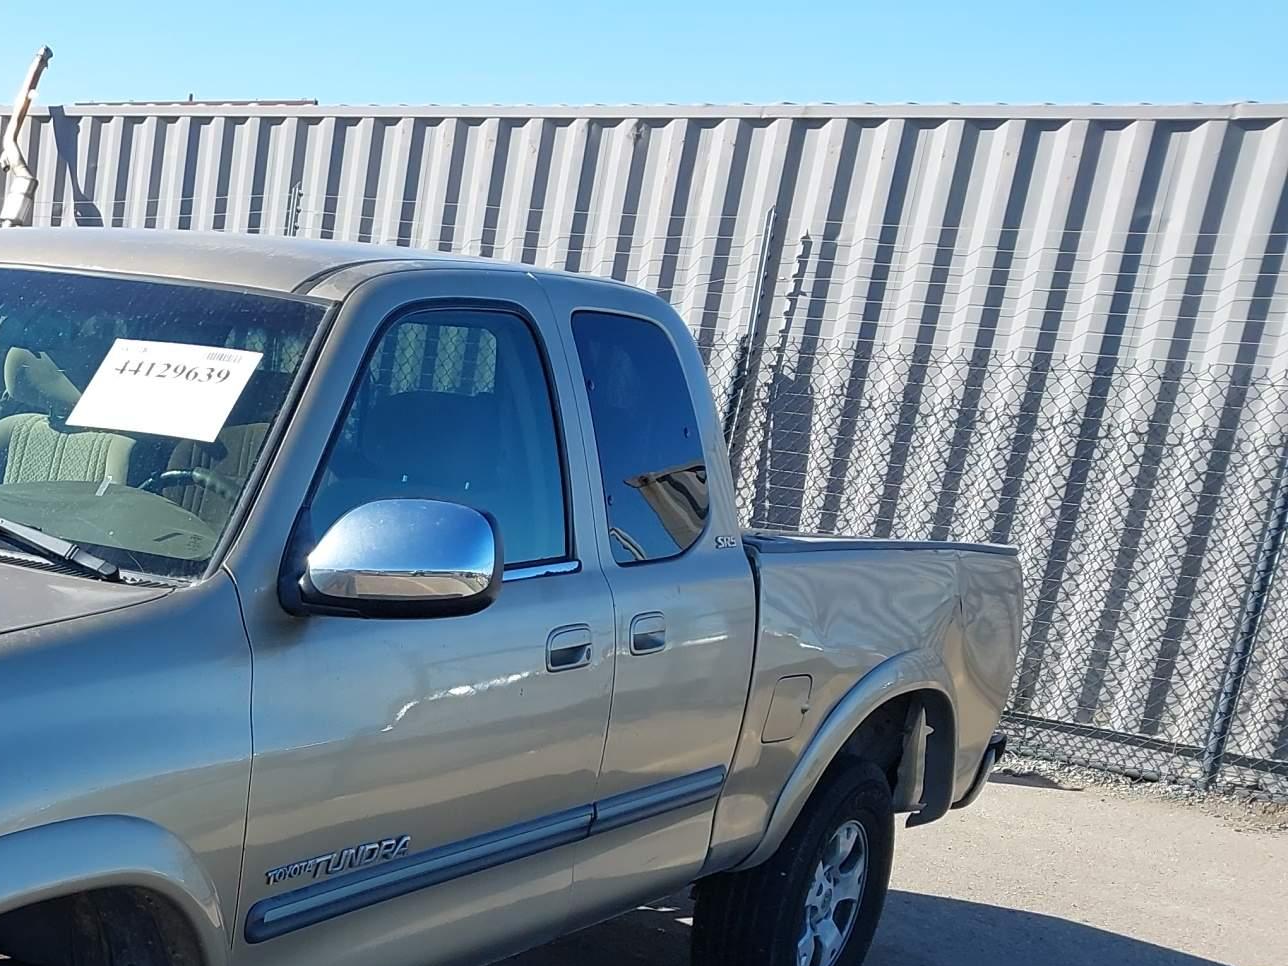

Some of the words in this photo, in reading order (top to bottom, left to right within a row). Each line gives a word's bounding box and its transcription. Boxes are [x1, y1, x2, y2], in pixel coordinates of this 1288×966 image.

[114, 359, 231, 384] 44129639
[715, 536, 737, 549] SR5
[267, 860, 314, 885] TOYOTA
[314, 835, 411, 878] TUNDRA
